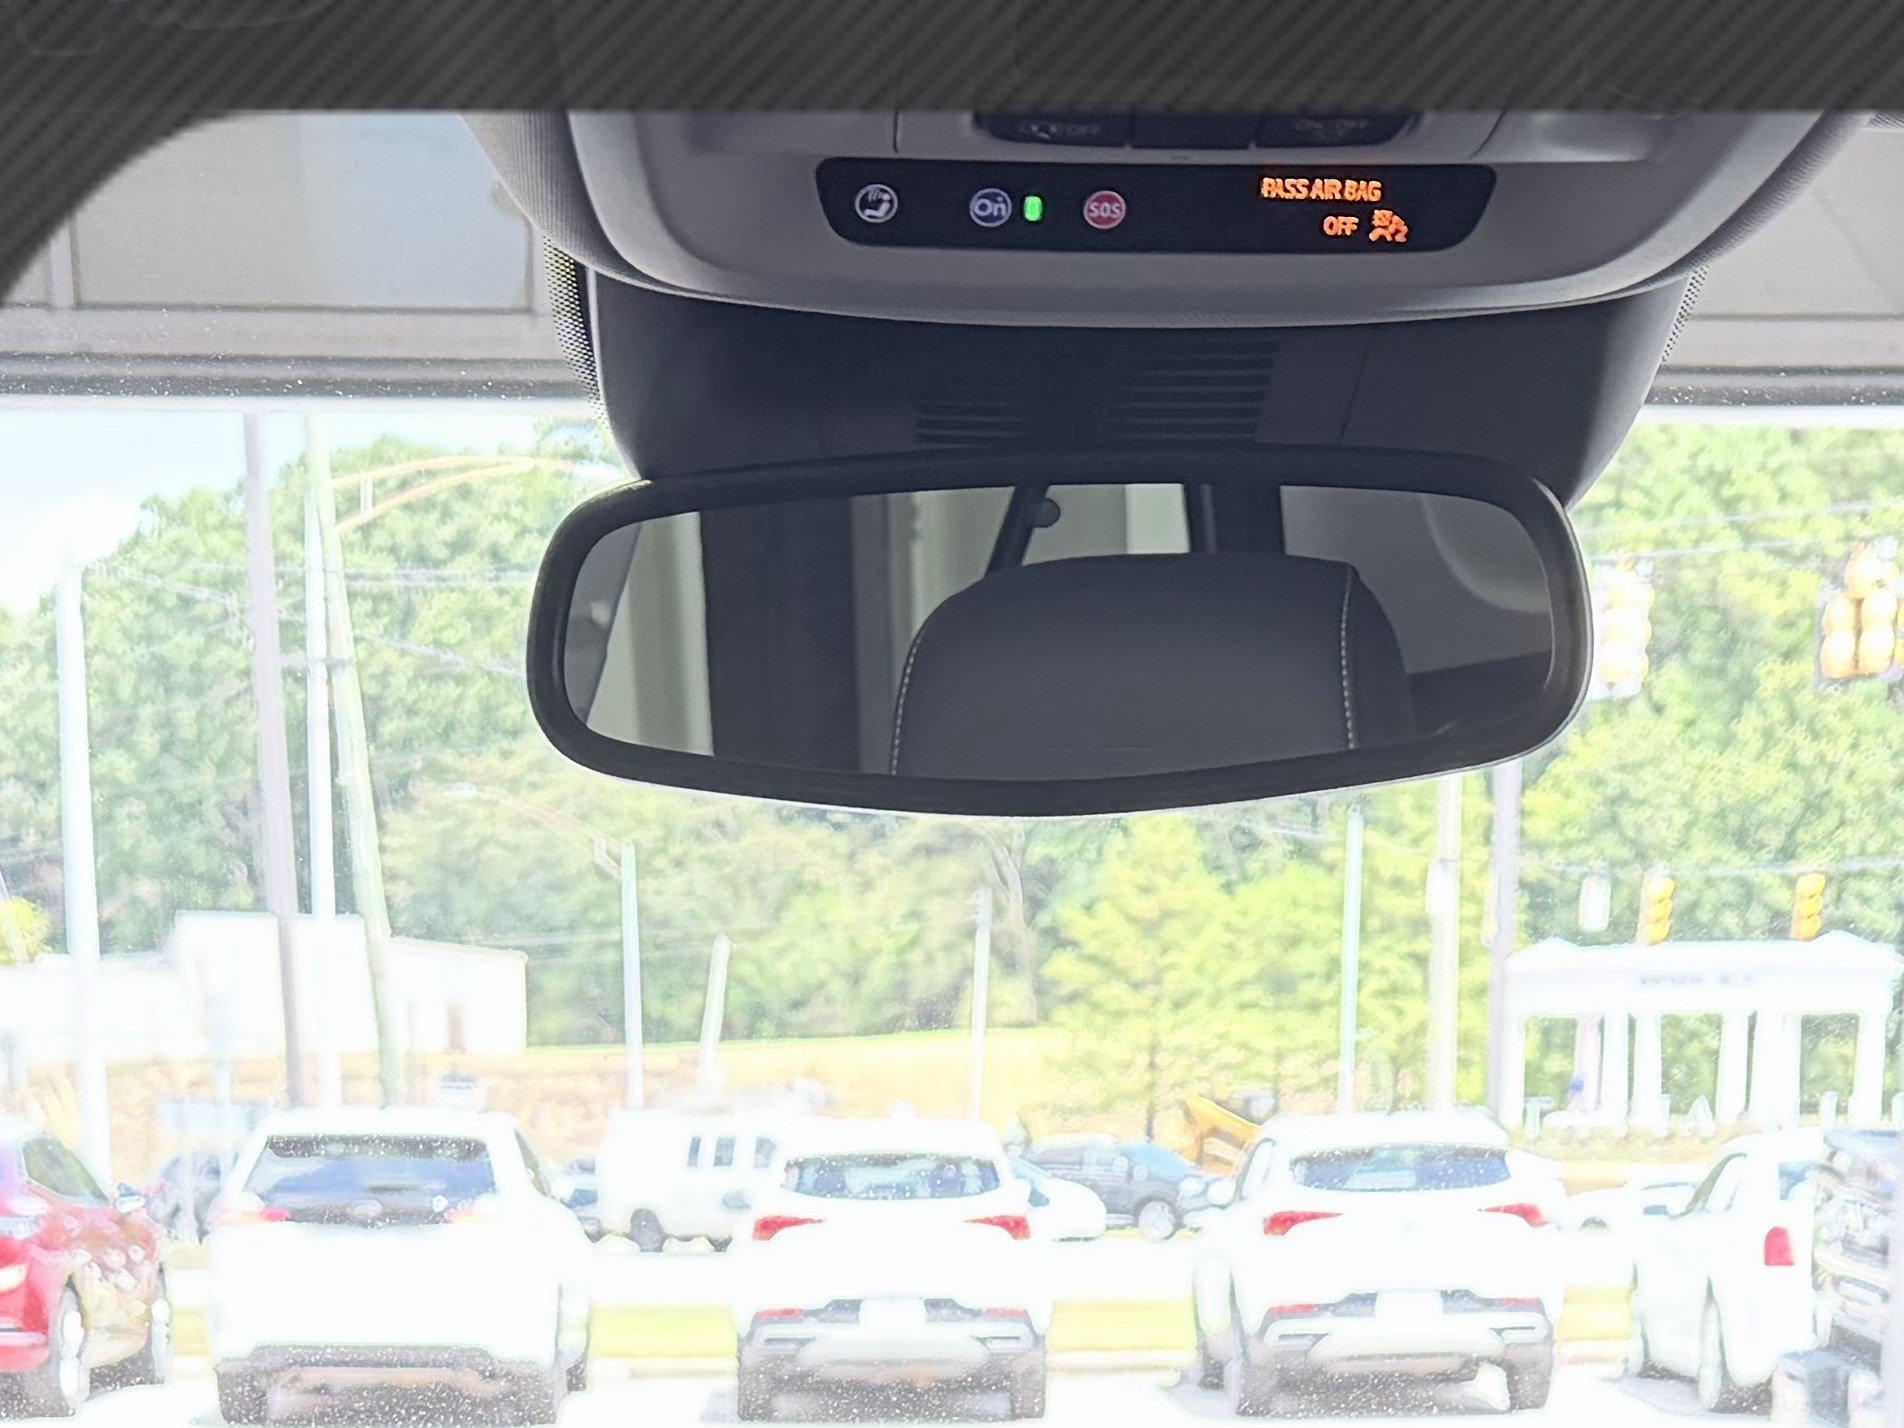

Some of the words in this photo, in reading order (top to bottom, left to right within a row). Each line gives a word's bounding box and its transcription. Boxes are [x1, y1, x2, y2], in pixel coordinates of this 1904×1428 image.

[1260, 177, 1310, 200] PASS
[1310, 178, 1343, 200] AIR
[1343, 179, 1382, 202] BAG
[1088, 201, 1121, 218] SOS
[1322, 215, 1360, 236] OFF
